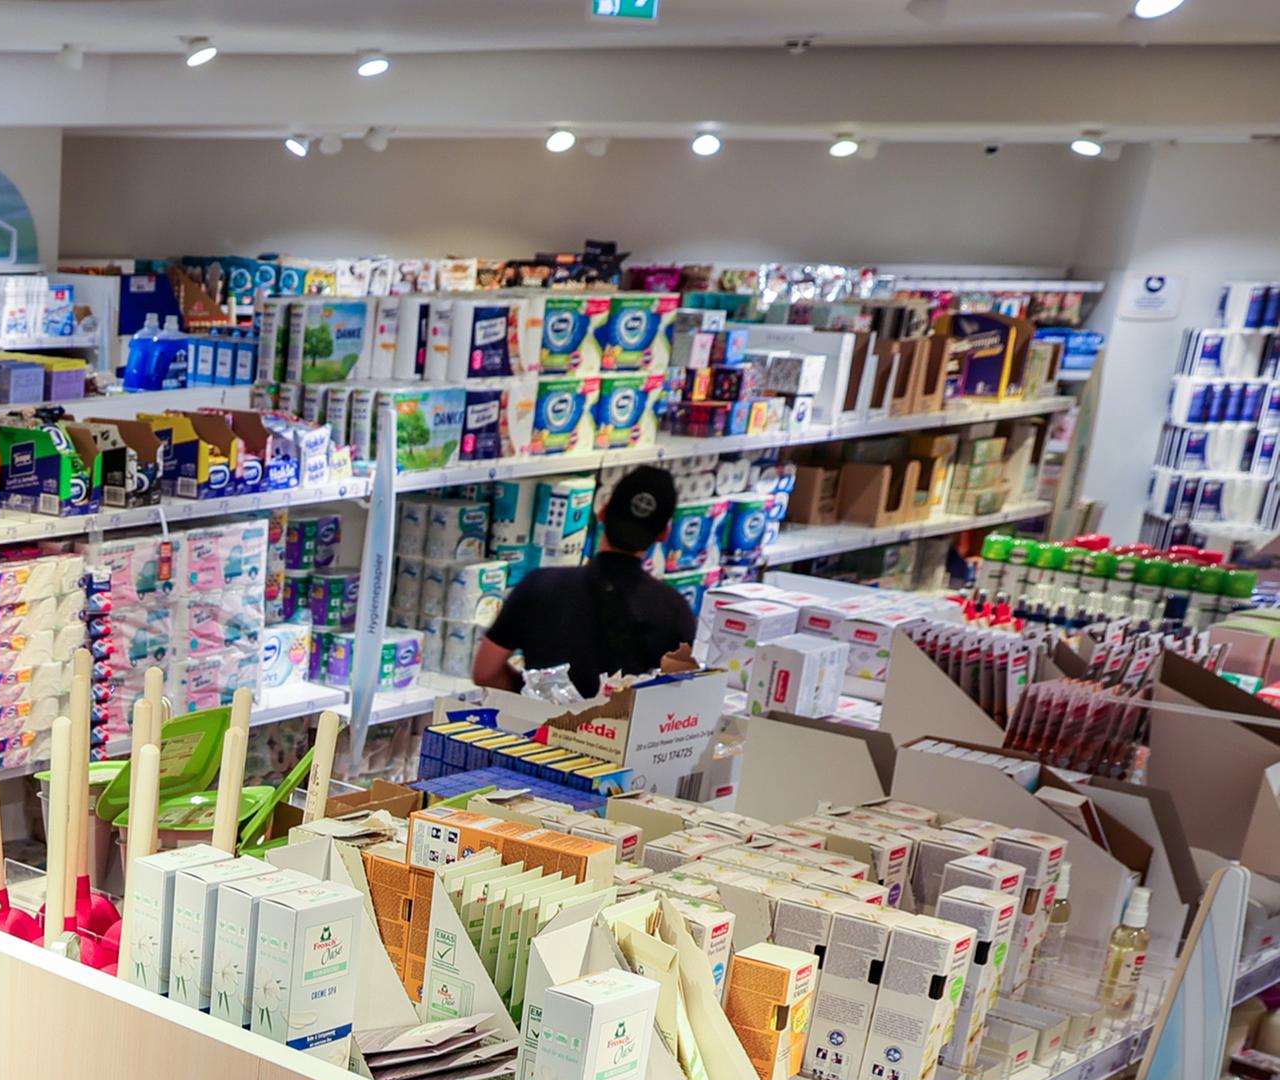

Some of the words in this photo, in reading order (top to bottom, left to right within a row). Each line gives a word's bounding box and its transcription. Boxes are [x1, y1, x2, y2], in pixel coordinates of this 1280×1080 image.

[368, 553, 384, 635] Hygienepapier
[578, 722, 617, 740] leda
[658, 712, 700, 734] vileda
[435, 929, 457, 943] EMAS
[312, 938, 338, 951] Frosch
[606, 1036, 630, 1049] Frosch
